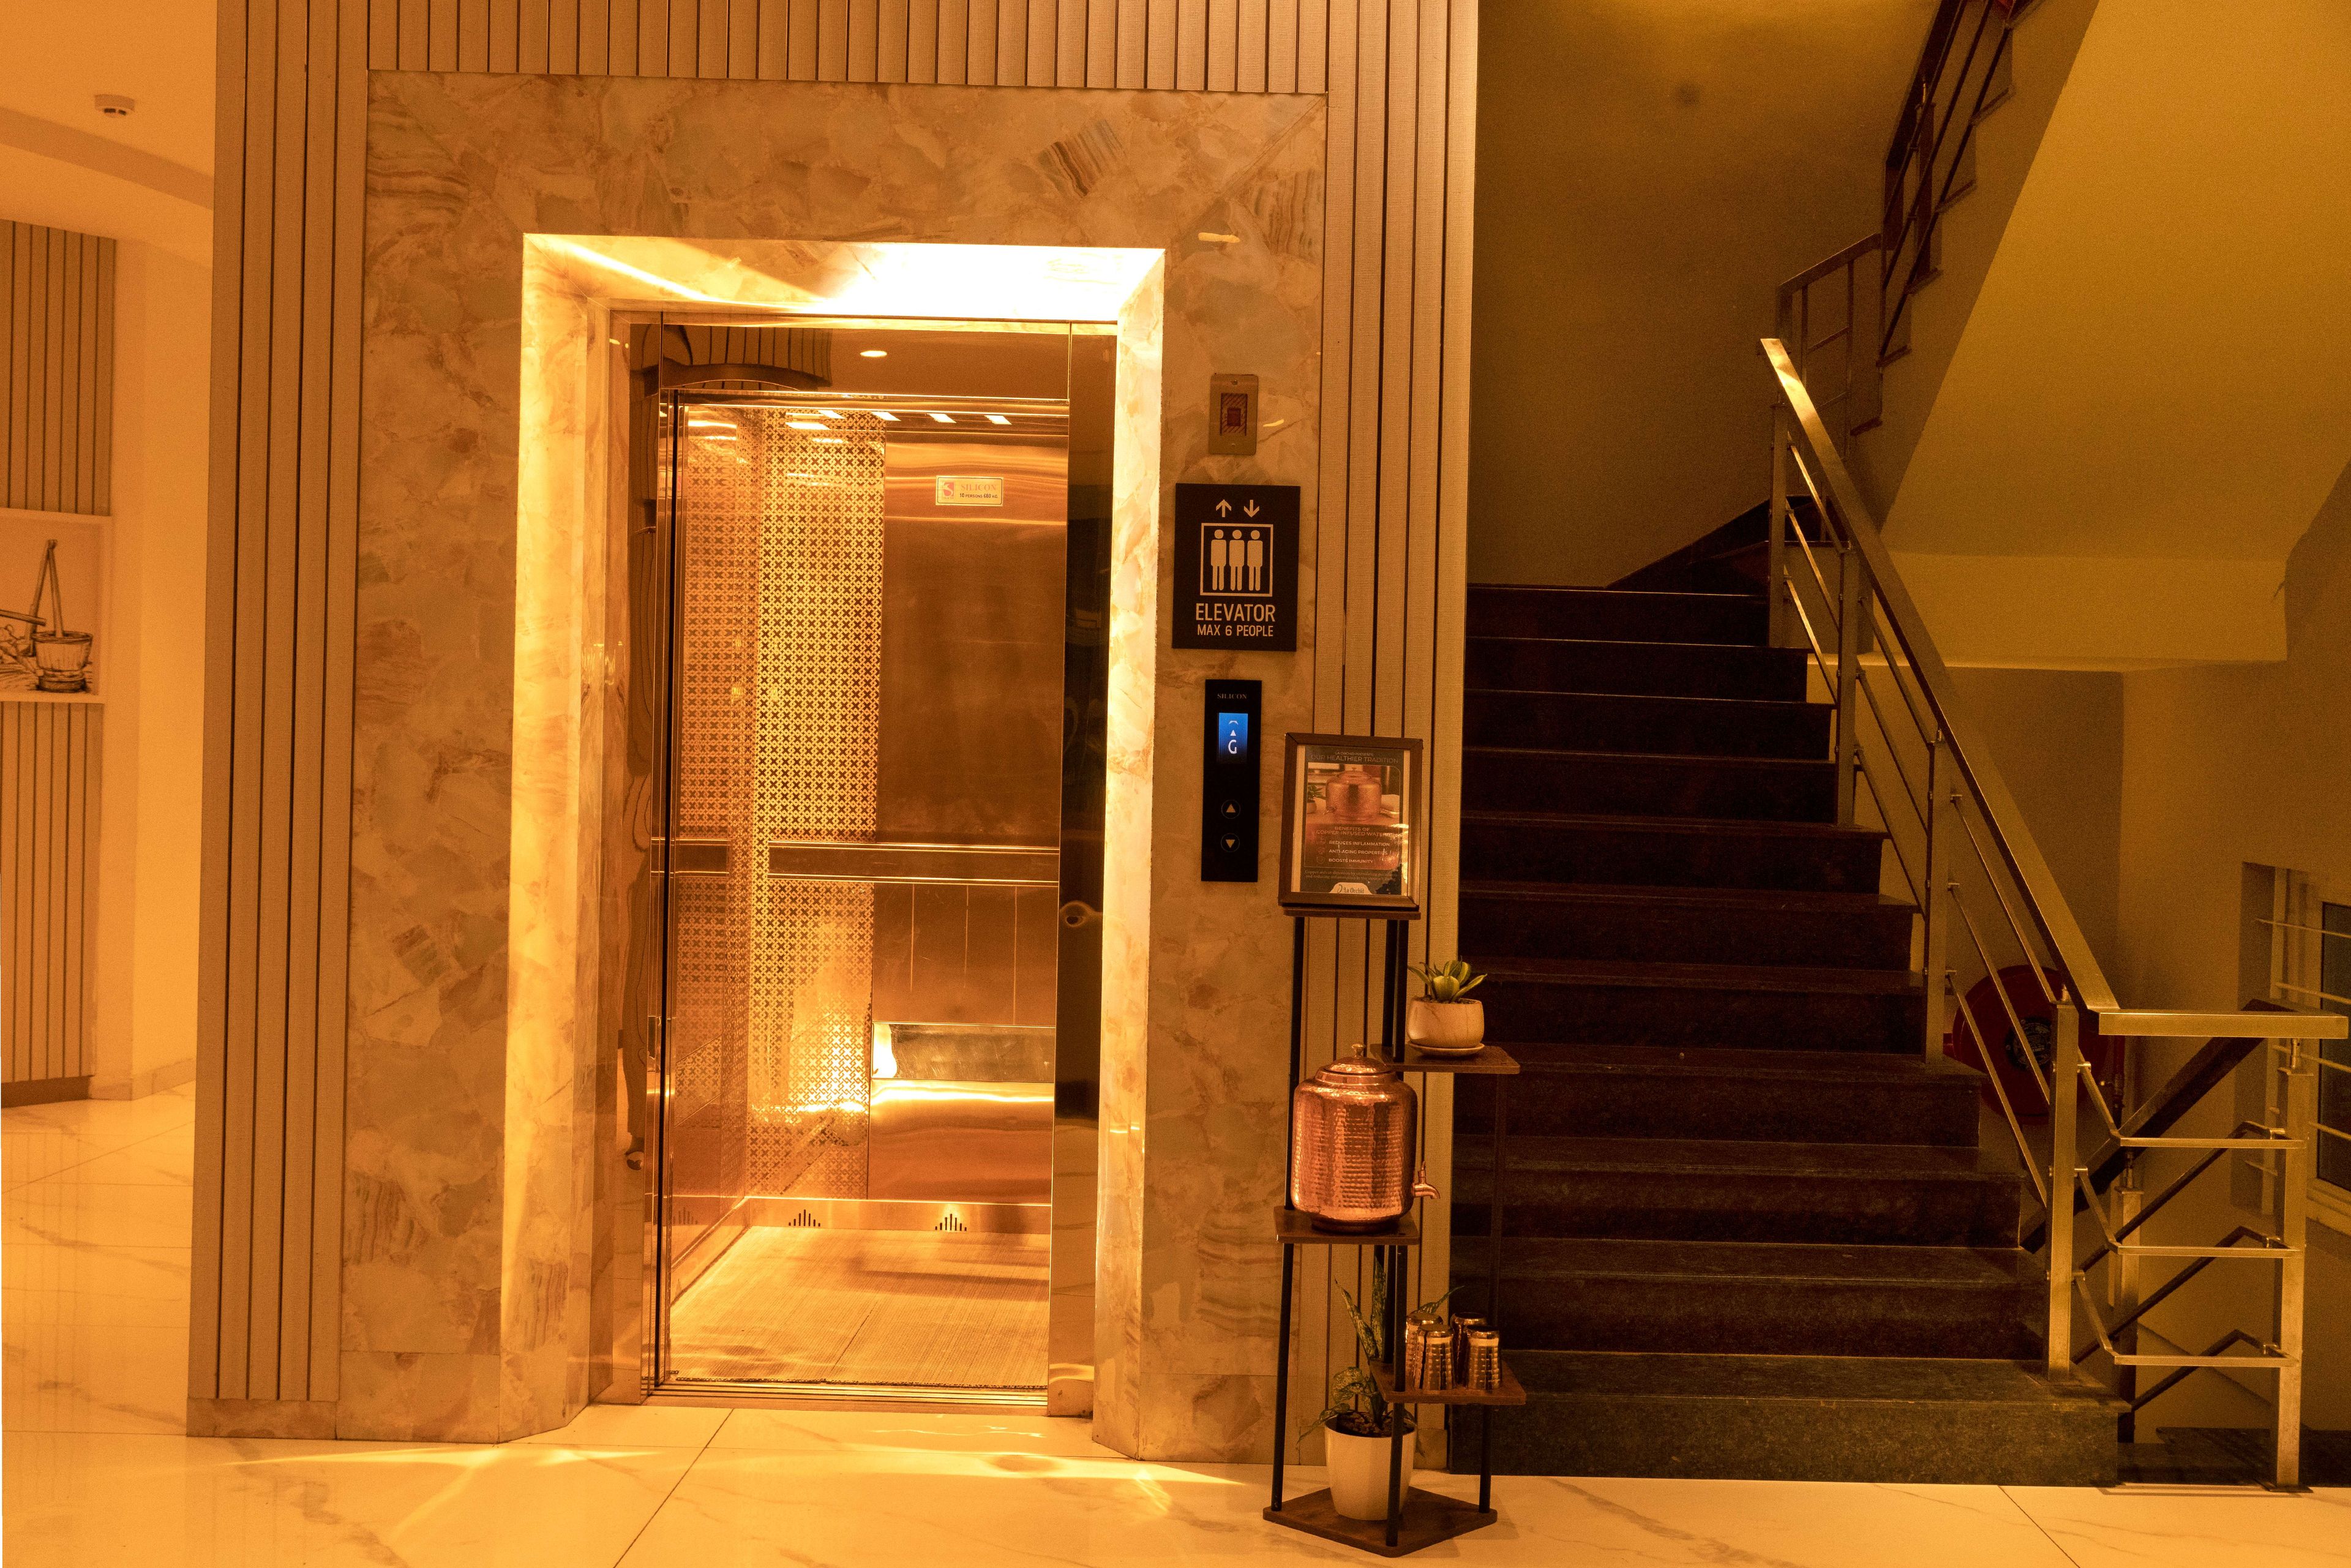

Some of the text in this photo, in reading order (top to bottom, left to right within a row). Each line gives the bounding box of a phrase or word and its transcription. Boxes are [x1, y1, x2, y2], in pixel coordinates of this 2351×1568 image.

[1196, 603, 1275, 622] ELEVATOR
[1198, 625, 1273, 637] MAX 6 PEOPLE
[1228, 739, 1237, 754] G
